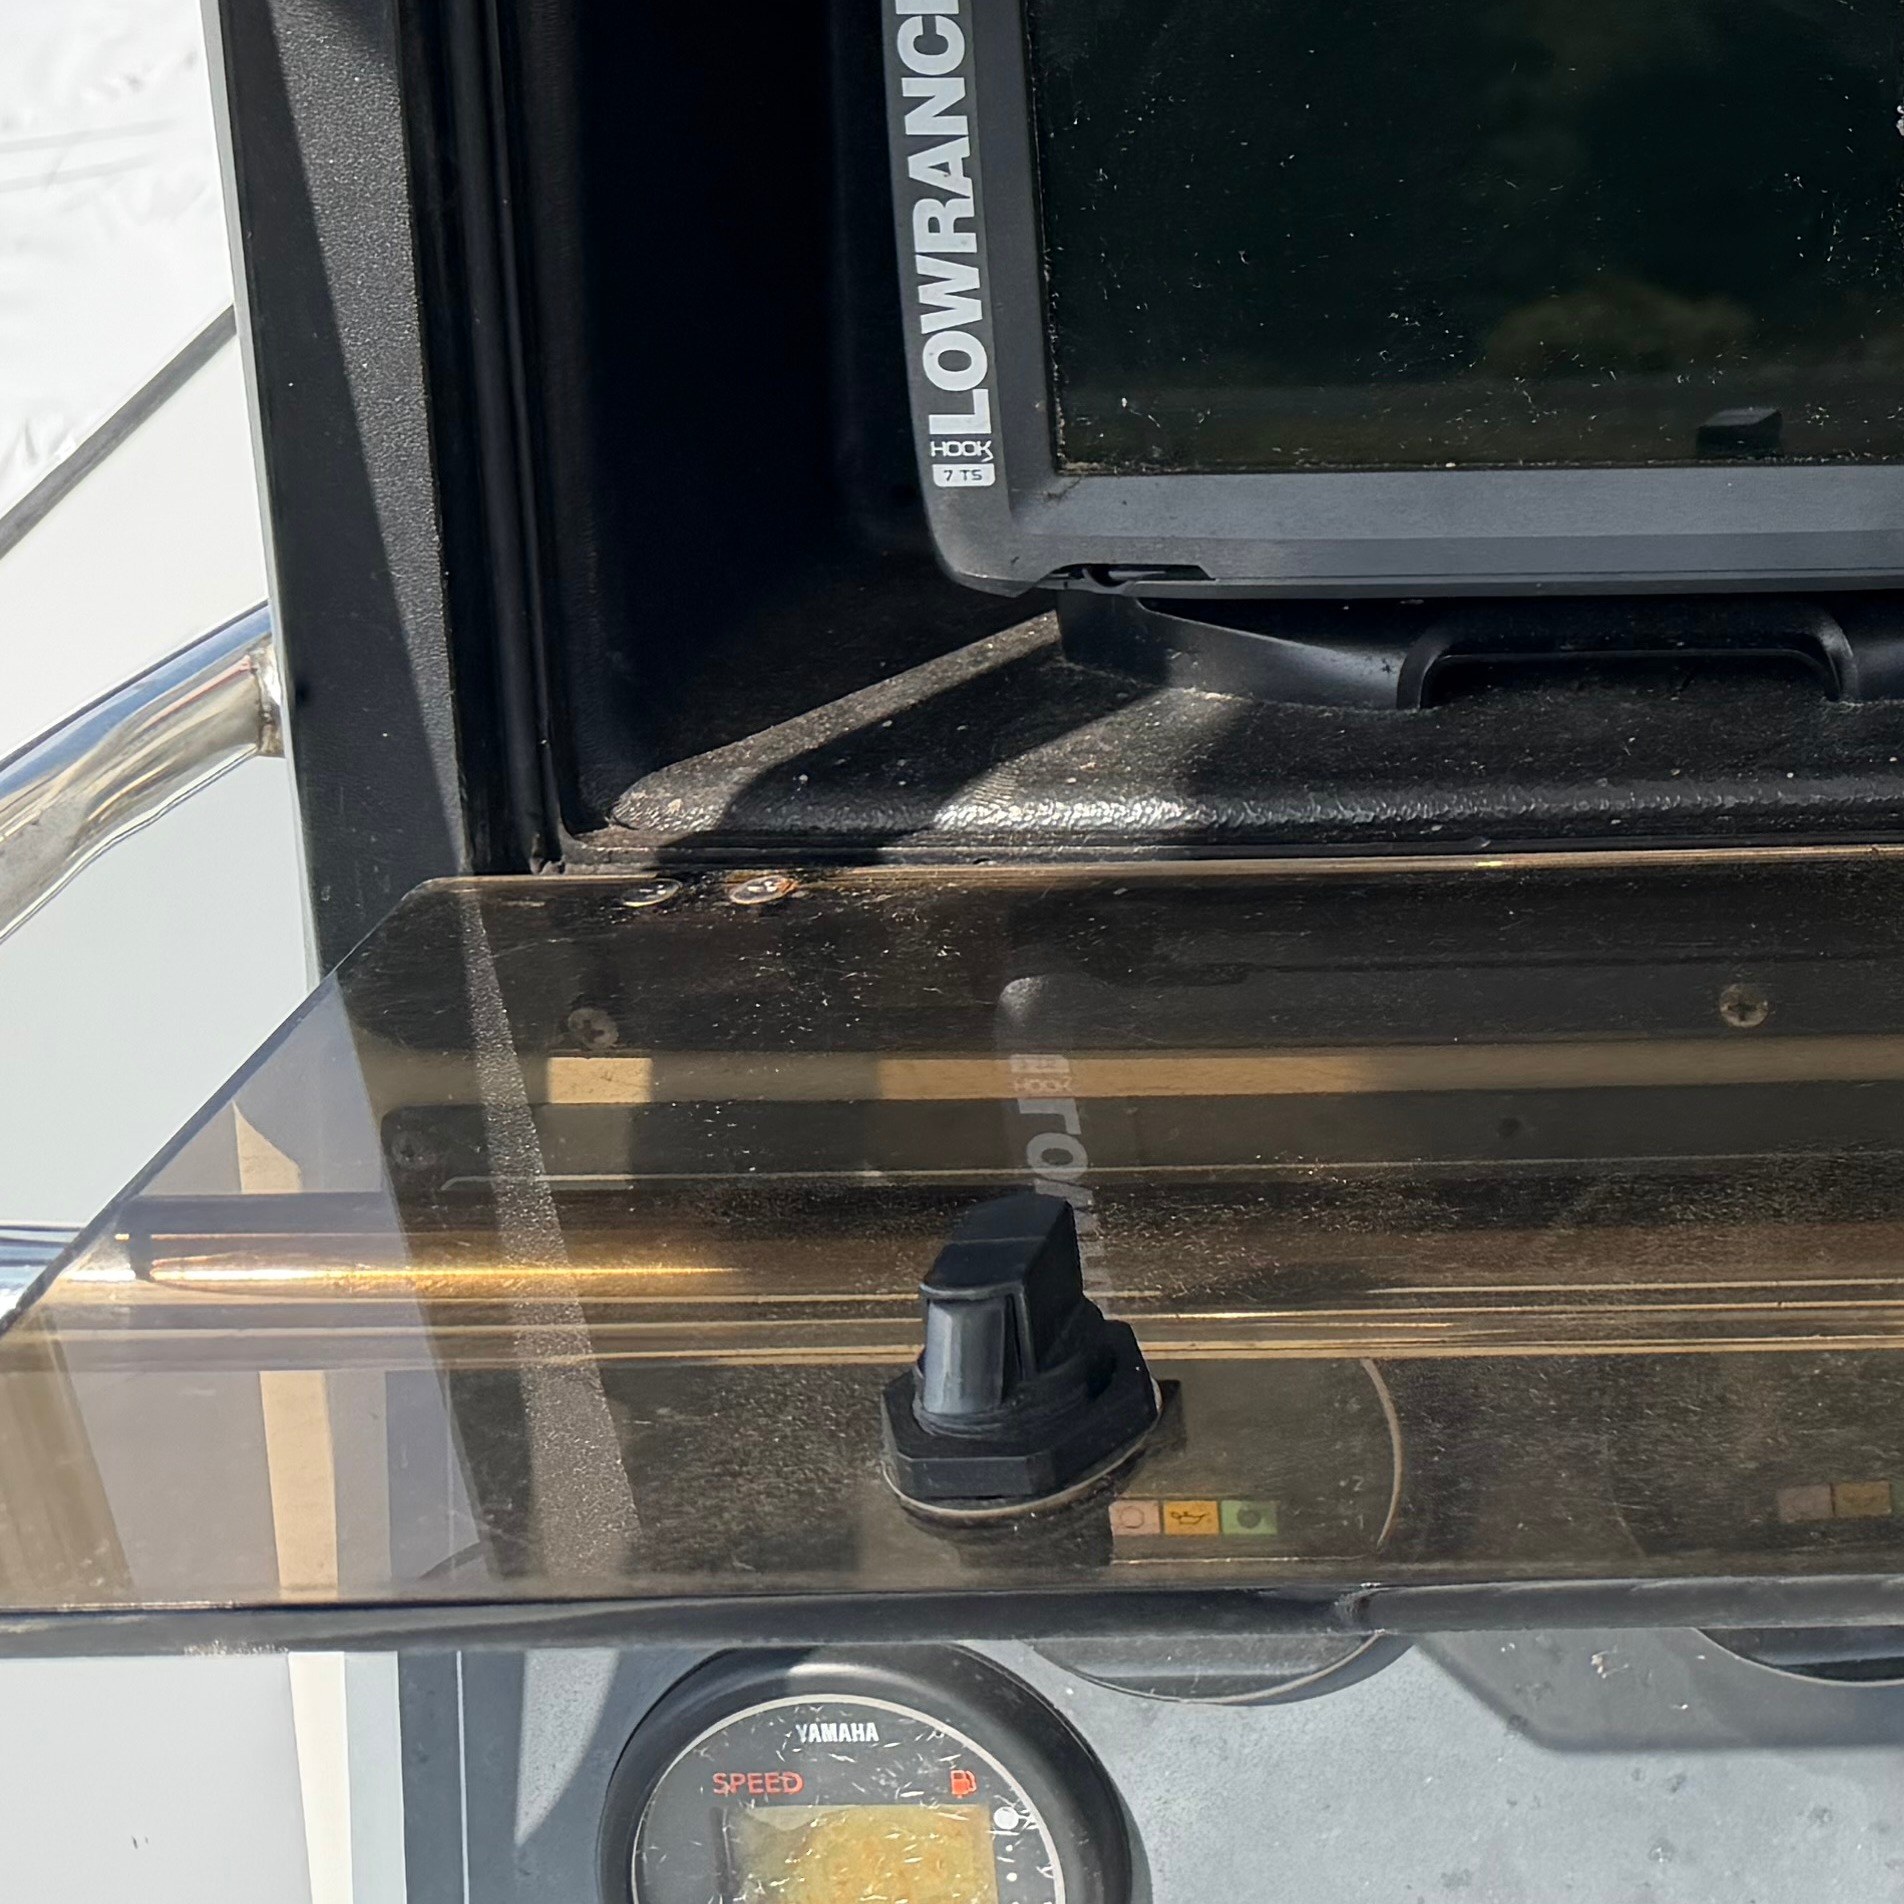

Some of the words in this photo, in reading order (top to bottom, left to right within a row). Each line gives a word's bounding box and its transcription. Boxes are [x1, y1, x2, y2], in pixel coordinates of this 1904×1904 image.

[929, 440, 994, 463] HOOK
[943, 469, 954, 482] 7
[959, 469, 983, 482] TS
[795, 1721, 881, 1745] YAMAHA
[711, 1771, 805, 1795] SPEED
